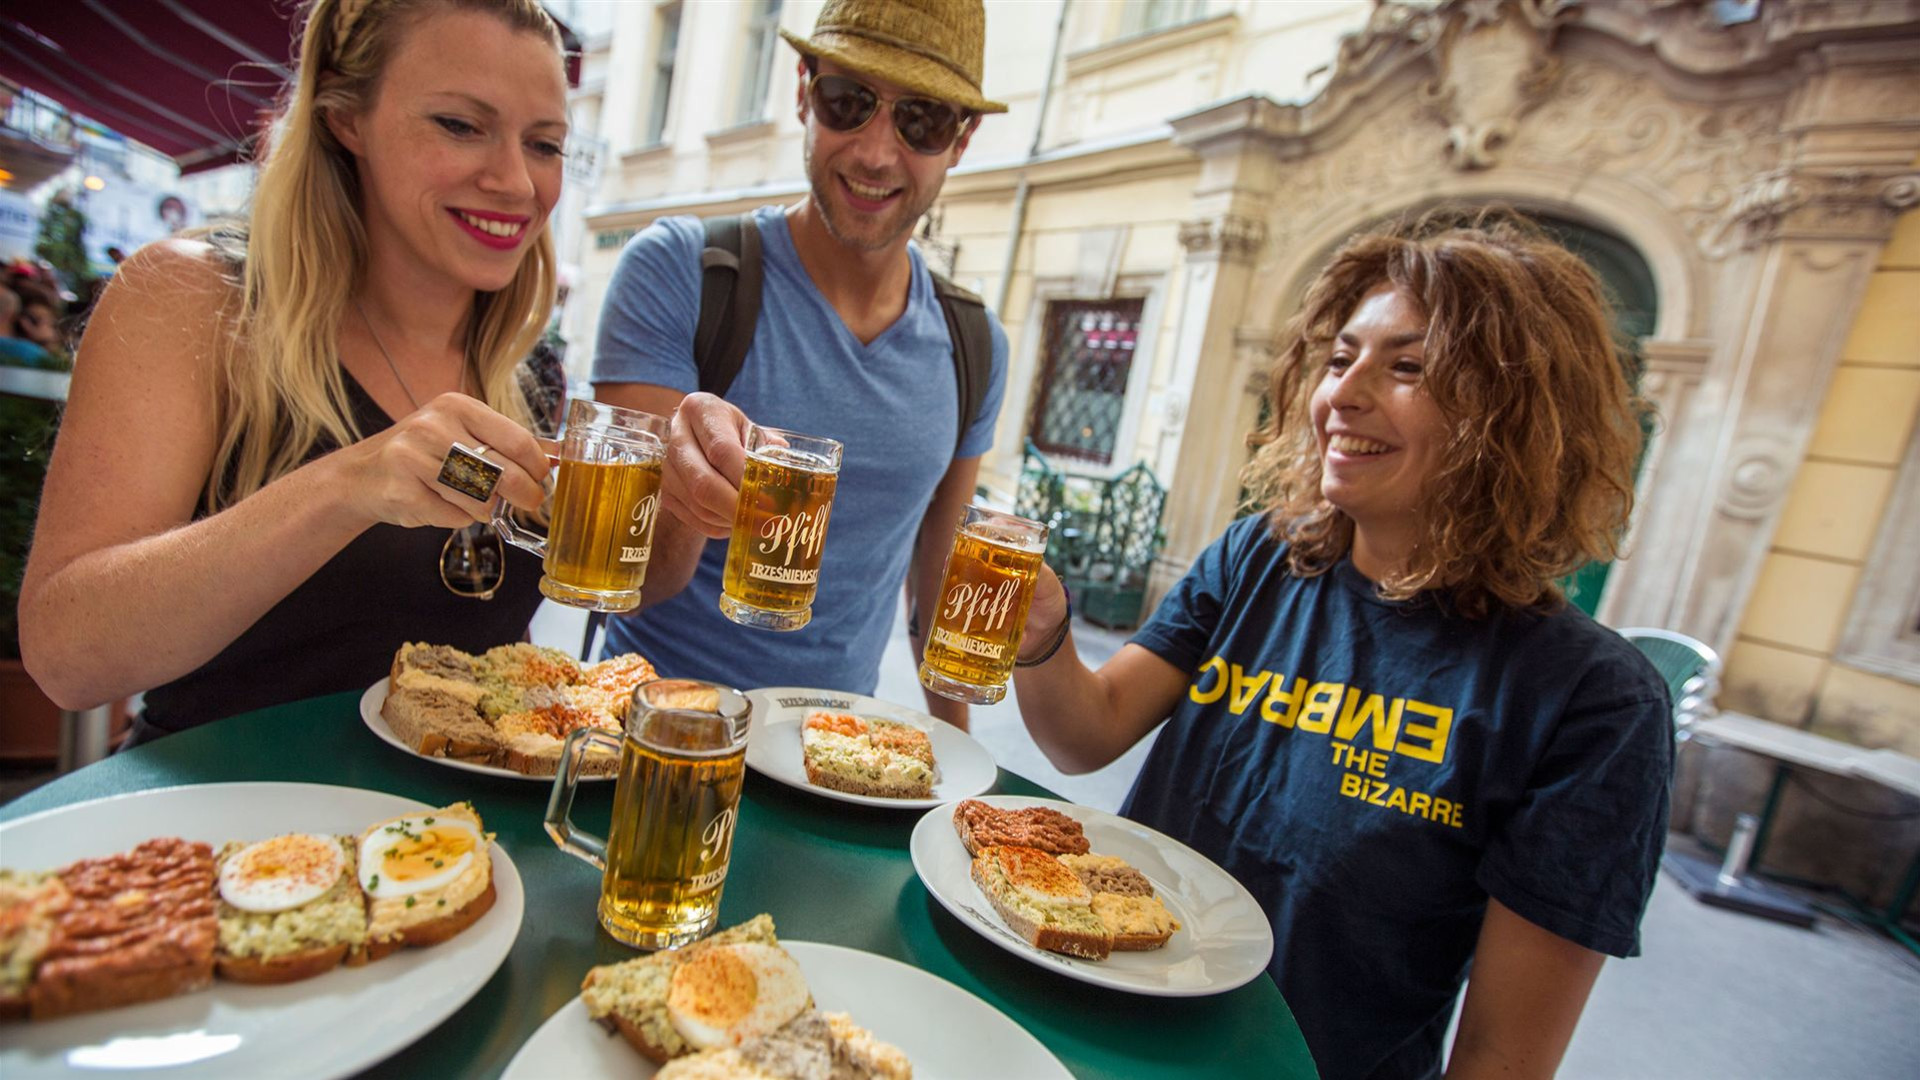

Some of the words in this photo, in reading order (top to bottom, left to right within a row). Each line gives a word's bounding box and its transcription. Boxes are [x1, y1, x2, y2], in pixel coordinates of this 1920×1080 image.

[759, 500, 831, 567] Pfiff
[944, 578, 1020, 634] Pfiff
[1331, 742, 1389, 778] THE
